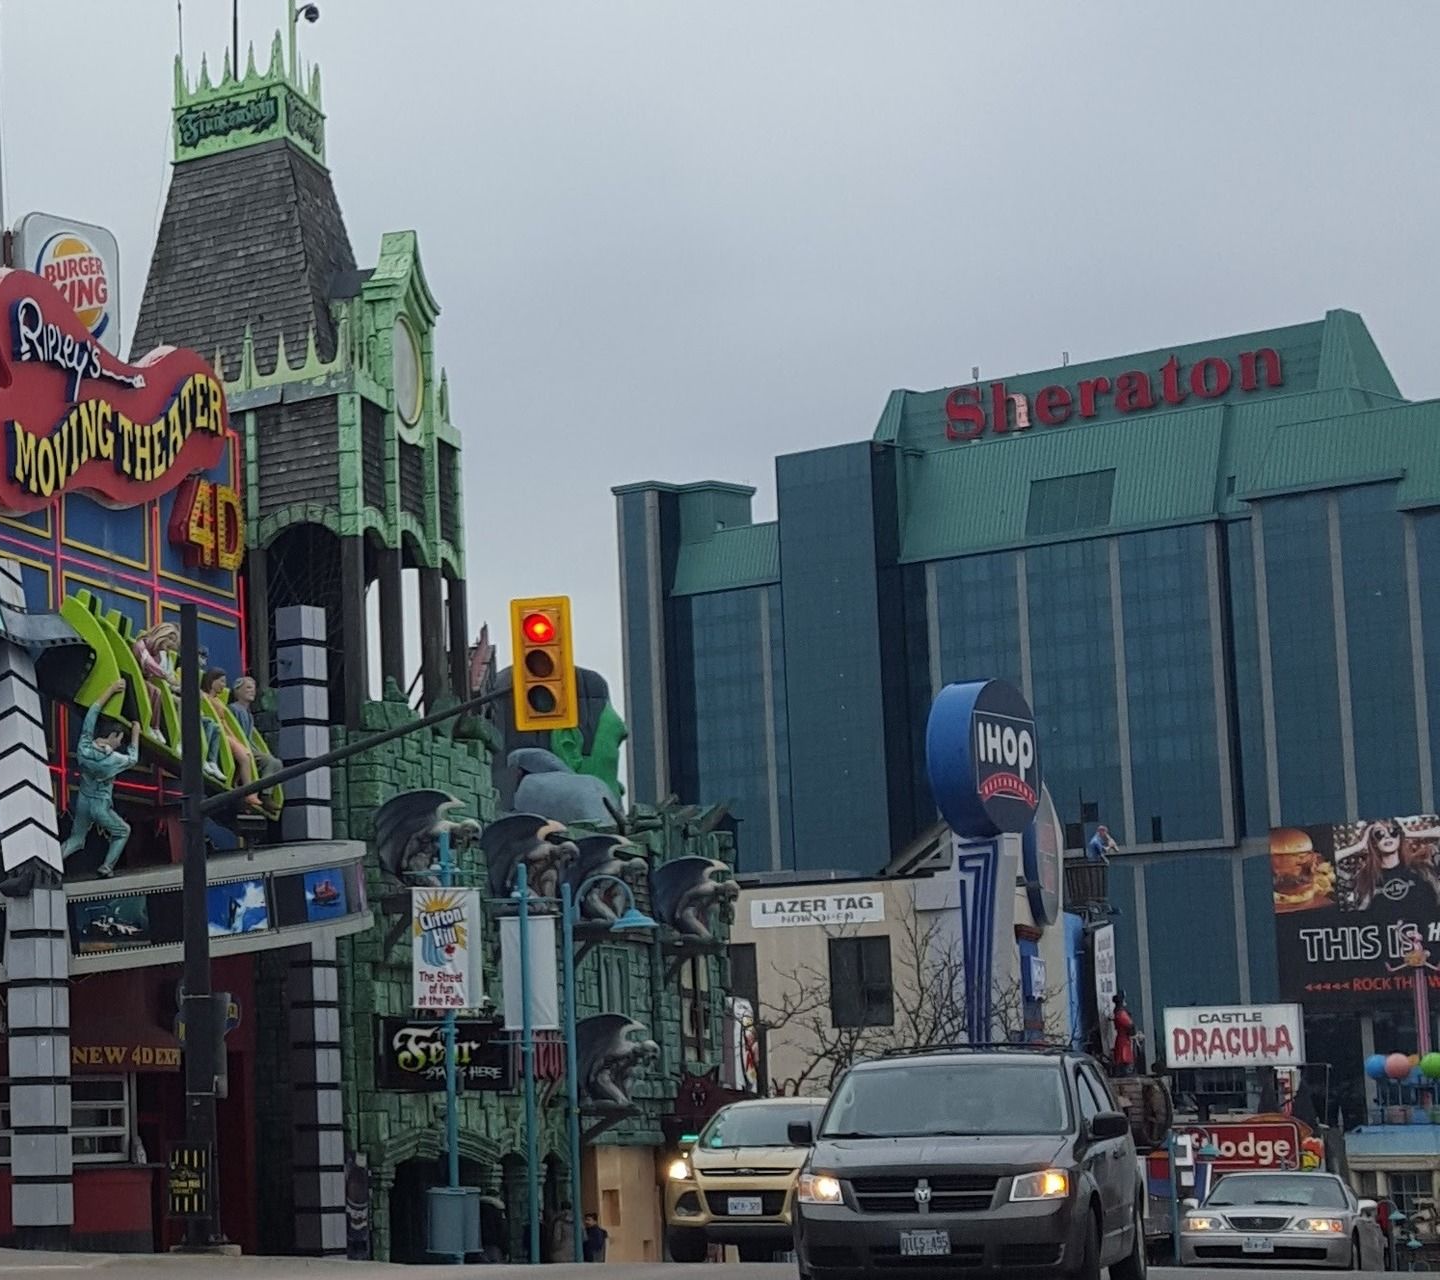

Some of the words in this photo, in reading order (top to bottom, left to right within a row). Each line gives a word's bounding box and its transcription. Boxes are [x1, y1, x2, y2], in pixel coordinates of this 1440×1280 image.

[44, 256, 105, 282] BURGER
[944, 347, 1283, 441] Sheraton
[13, 398, 115, 497] MOVING
[117, 373, 224, 482] THEATER
[188, 478, 247, 571] 4D
[978, 721, 1034, 782] IHOP
[761, 899, 827, 914] LAZER
[833, 896, 874, 910] TAG
[420, 908, 463, 931] Clifton
[781, 913, 812, 924] NOW
[431, 925, 458, 948] Hill
[1299, 925, 1382, 962] THIS
[419, 970, 435, 982] The
[436, 971, 463, 983] Street
[1352, 977, 1392, 992] ROCK
[1394, 975, 1416, 991] TH
[429, 983, 438, 994] of
[439, 983, 454, 994] fun
[418, 996, 427, 1006] at
[429, 995, 443, 1006] the
[445, 995, 464, 1006] Falls
[1198, 1012, 1263, 1024] CASTLE
[1172, 1024, 1294, 1062] DRACULA
[72, 1045, 128, 1066] NEW
[131, 1044, 153, 1066] 4D
[469, 1065, 503, 1080] HERE
